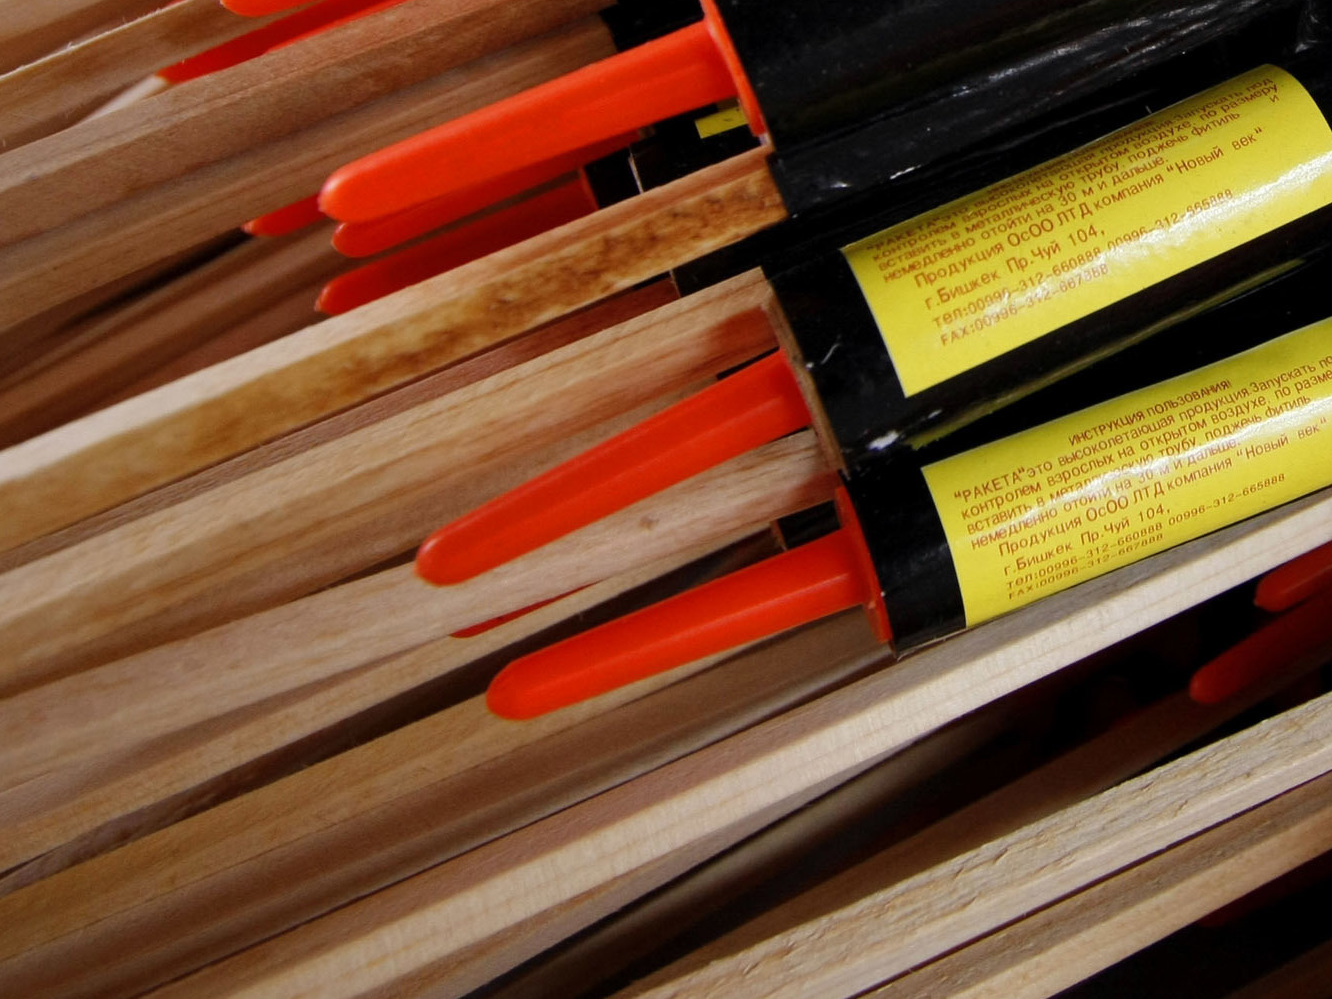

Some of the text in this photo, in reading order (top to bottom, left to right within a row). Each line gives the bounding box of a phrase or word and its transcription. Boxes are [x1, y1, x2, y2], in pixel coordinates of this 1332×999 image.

[913, 242, 1004, 287] Продукция
[1093, 173, 1164, 209] компания
[980, 212, 1032, 240] отойти
[1034, 202, 1054, 217] на
[1057, 191, 1077, 206] 30
[924, 270, 1000, 309] г.Бишкек
[1005, 240, 1061, 273] Пр.Чуй
[961, 481, 1041, 519] контролем
[1046, 453, 1115, 486] взрослых
[1116, 445, 1135, 459] на
[1139, 418, 1207, 450] открытом
[1273, 385, 1291, 399] по
[1068, 410, 1145, 446] ИНСТРУКЦИЯ
[998, 516, 1082, 556] Продукция
[1166, 457, 1232, 490] компания
[1003, 542, 1072, 575] г.Бишкек
[1080, 517, 1130, 545] Пр.Чуй
